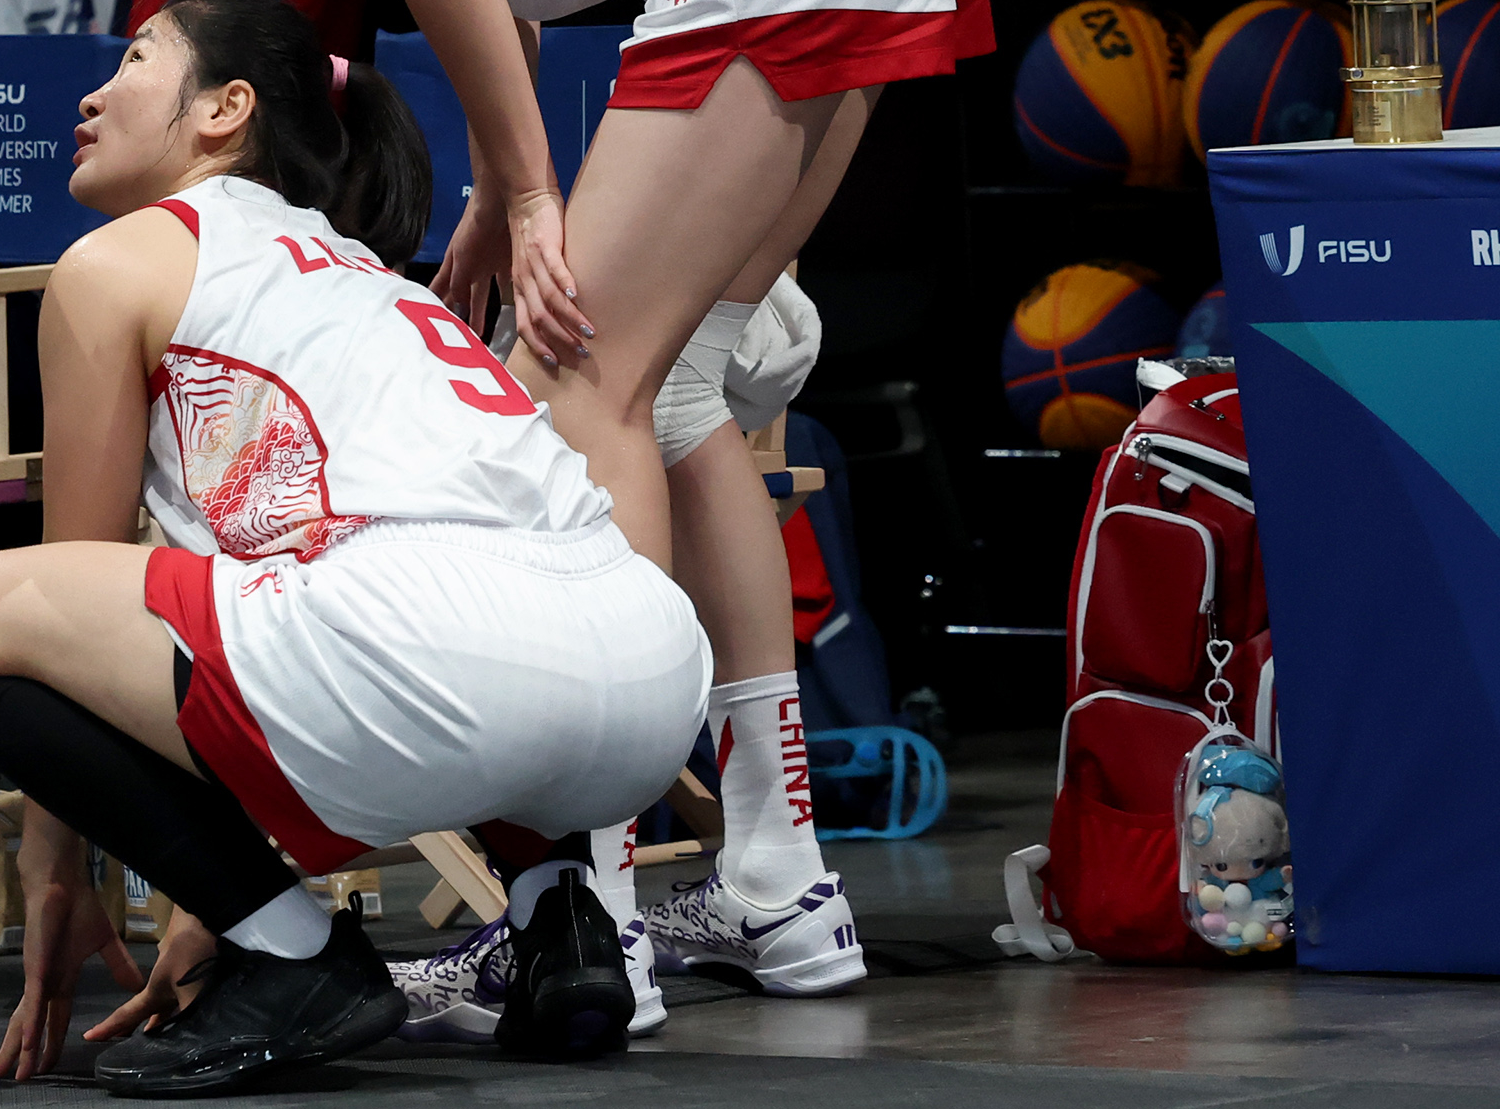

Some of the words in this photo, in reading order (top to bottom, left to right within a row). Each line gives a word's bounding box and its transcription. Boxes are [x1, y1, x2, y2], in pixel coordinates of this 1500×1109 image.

[1318, 239, 1392, 264] FISU
[395, 298, 538, 416] 9
[778, 696, 814, 828] CHINA
